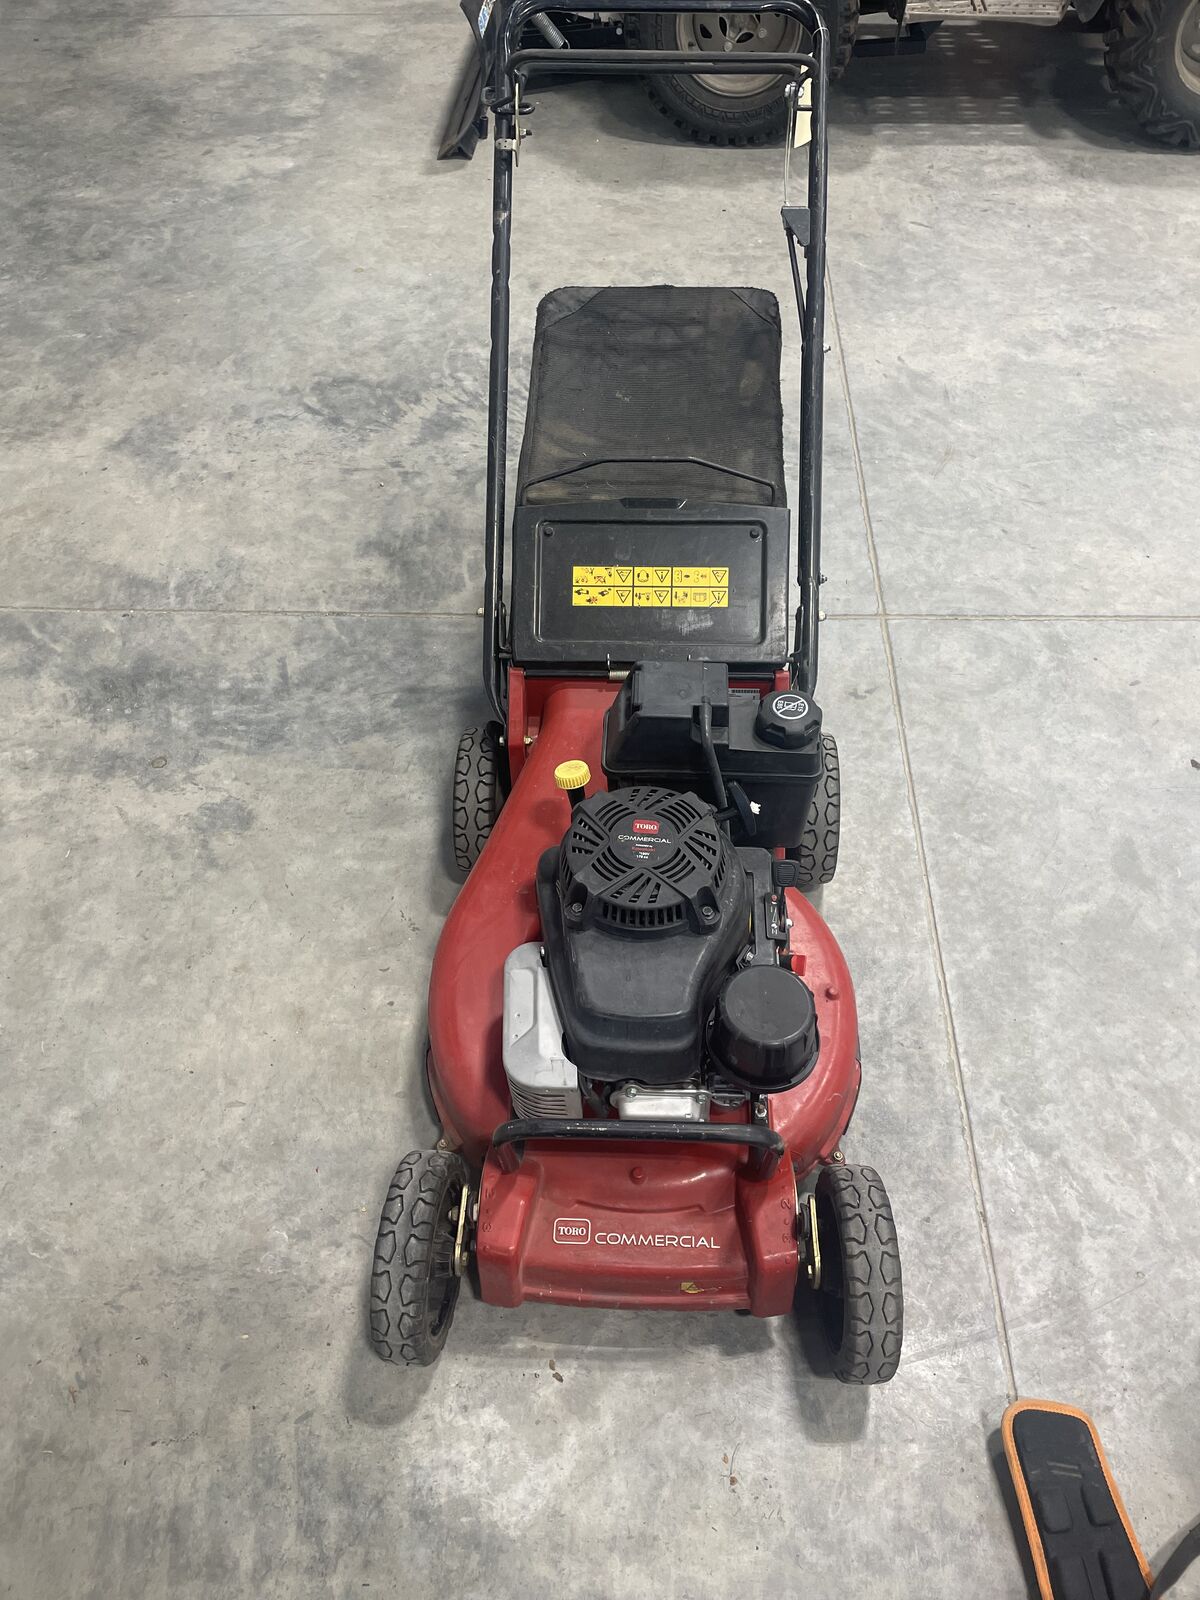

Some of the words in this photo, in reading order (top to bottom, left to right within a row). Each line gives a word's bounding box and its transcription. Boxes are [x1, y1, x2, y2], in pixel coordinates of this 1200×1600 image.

[635, 823, 657, 831] TORO
[618, 834, 672, 844] COMMERCIAL
[558, 1226, 587, 1236] TORO
[594, 1232, 721, 1249] COMMERCIAL
